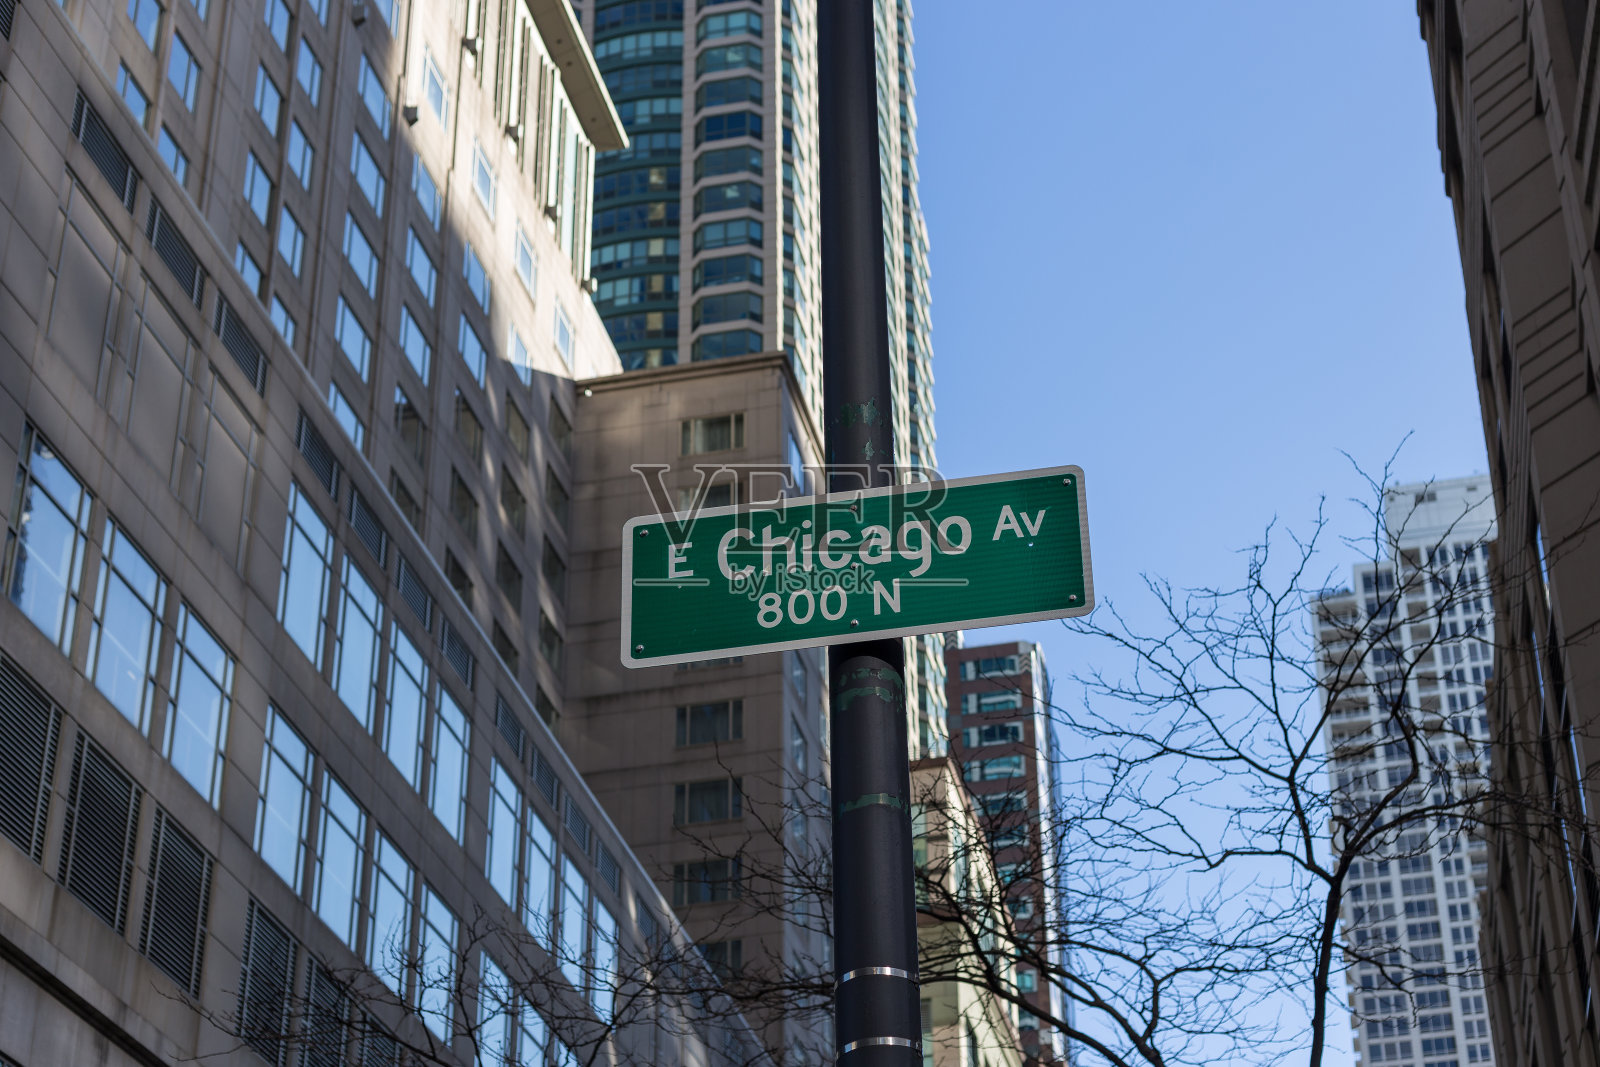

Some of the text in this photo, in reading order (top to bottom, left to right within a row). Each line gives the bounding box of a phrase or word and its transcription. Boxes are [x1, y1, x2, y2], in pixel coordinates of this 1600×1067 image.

[668, 504, 1046, 581] E Chicago Av
[757, 578, 901, 628] 800 N
